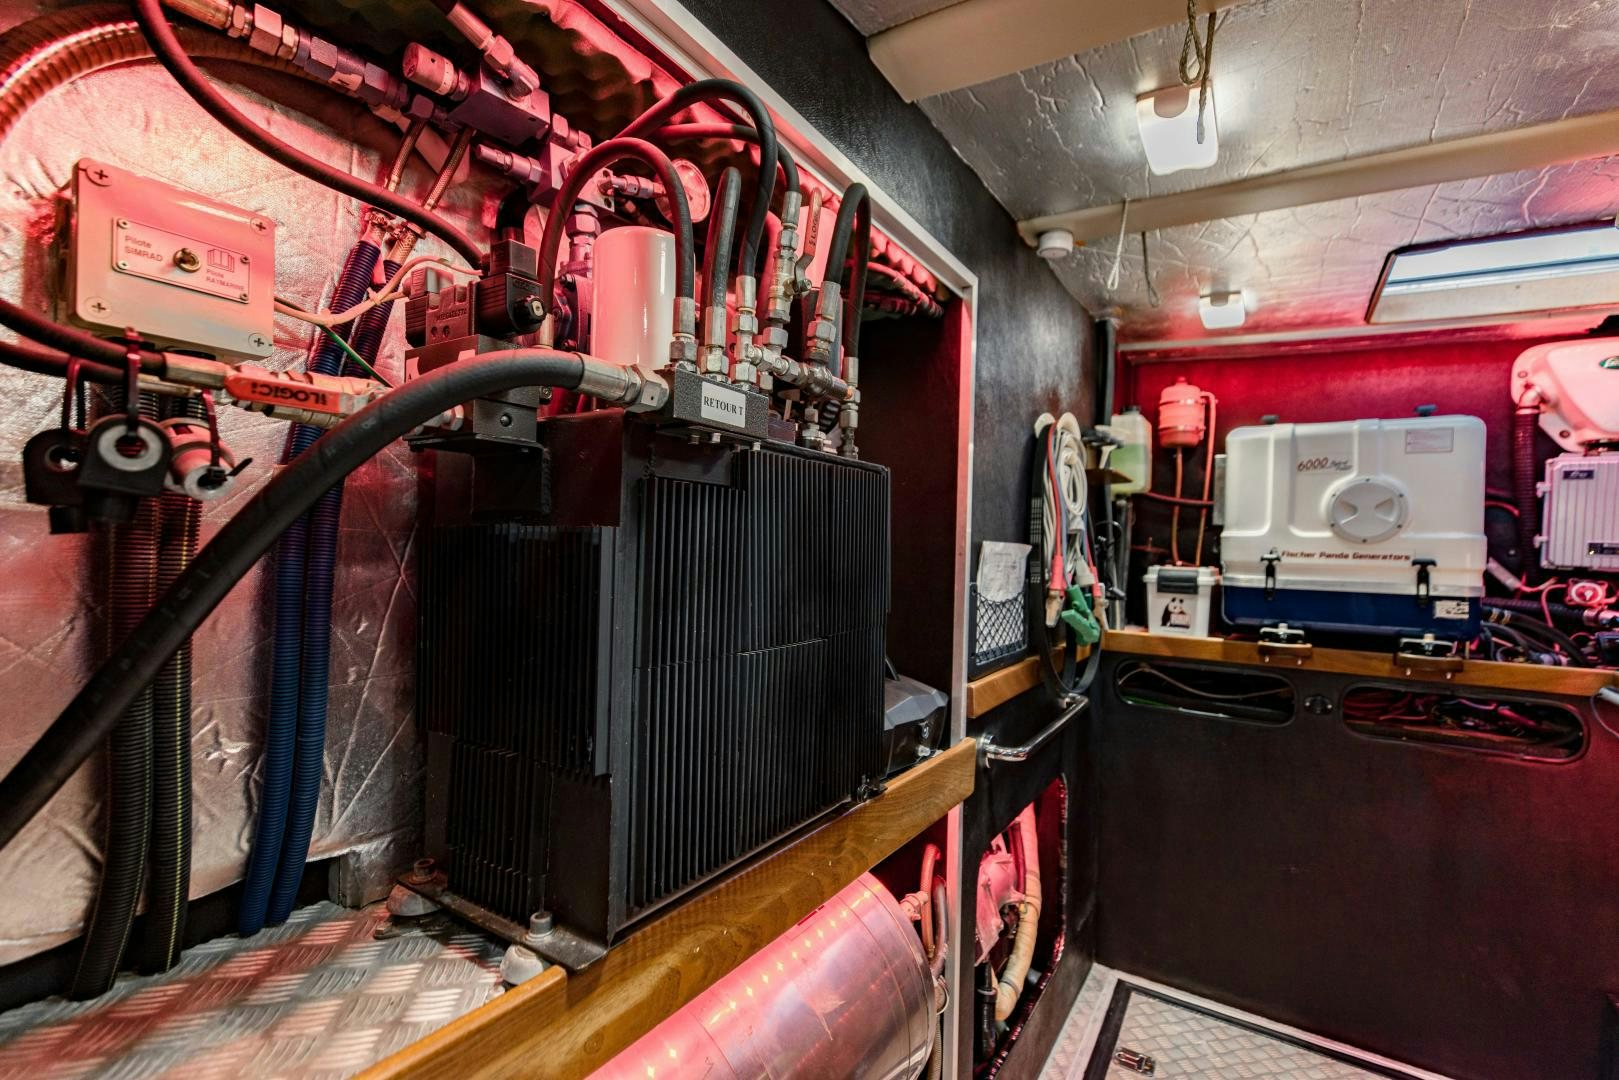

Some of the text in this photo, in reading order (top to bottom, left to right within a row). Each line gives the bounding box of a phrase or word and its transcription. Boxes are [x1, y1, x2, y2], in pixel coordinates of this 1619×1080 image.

[125, 235, 152, 248] Pilote
[125, 246, 163, 262] SIMRAD
[704, 396, 744, 416] RETOUR T
[1297, 456, 1329, 472] 6000
[1281, 550, 1411, 561] Fischer Panda Generators
